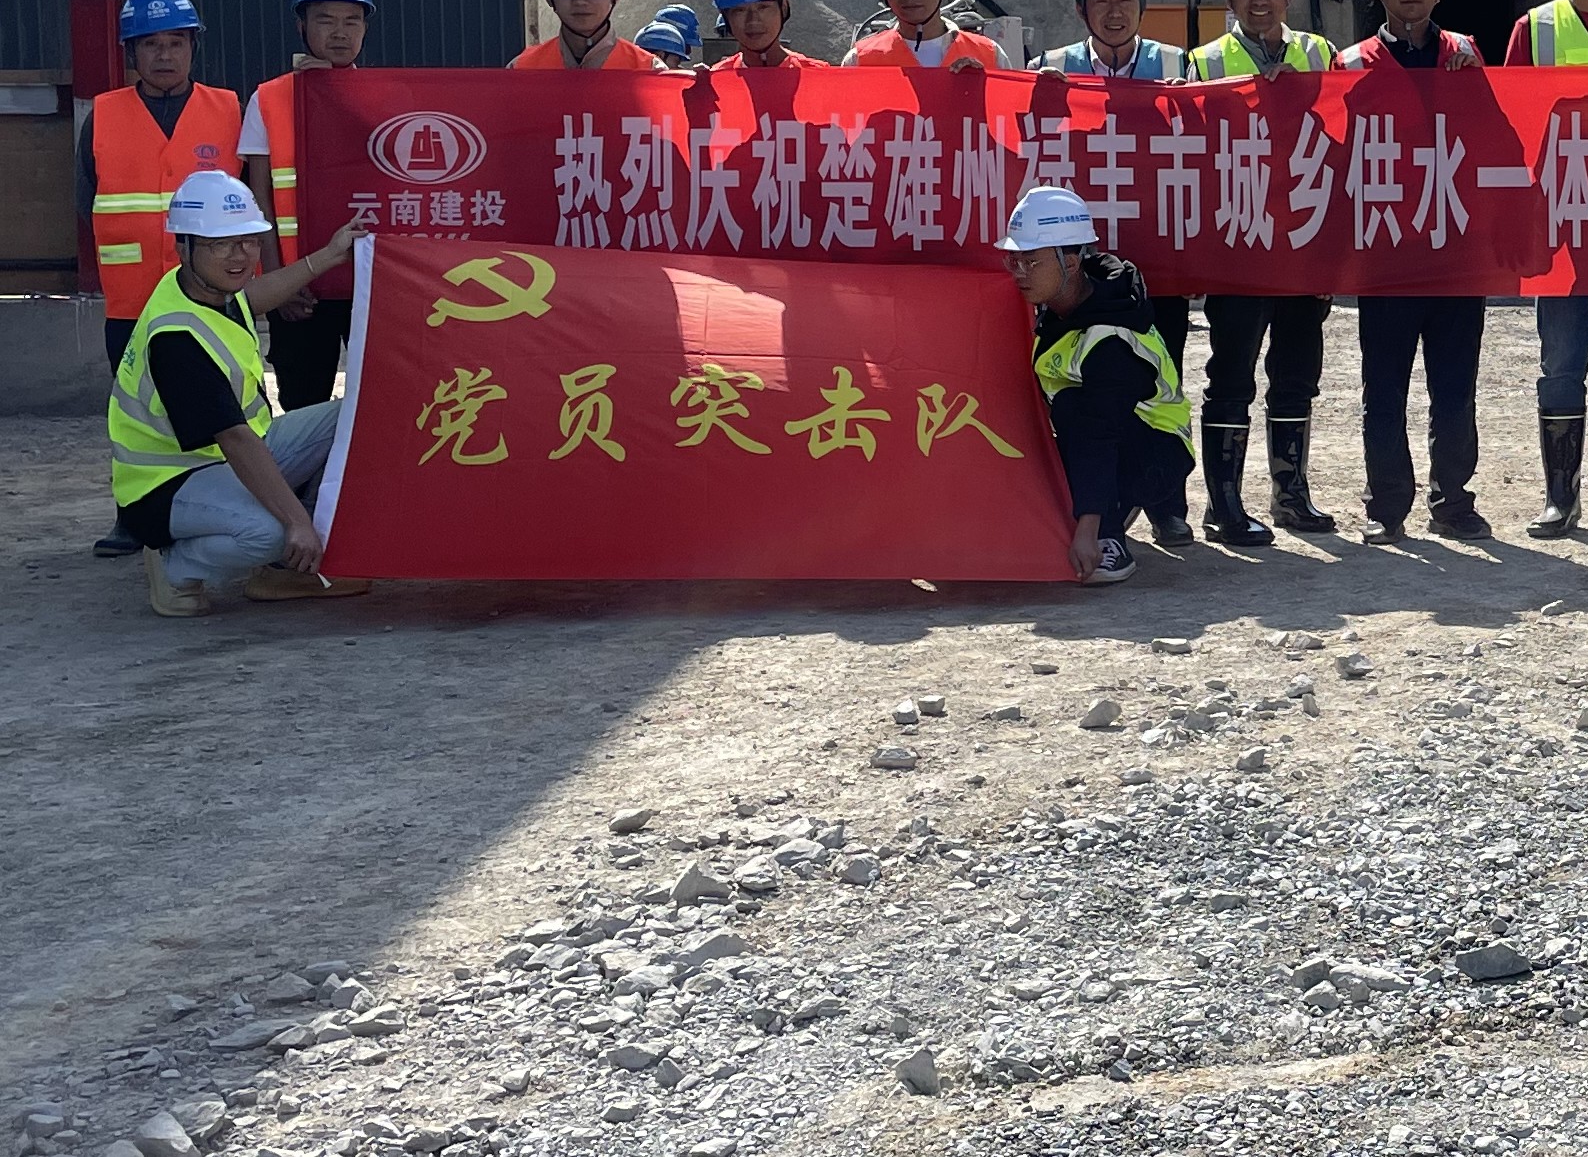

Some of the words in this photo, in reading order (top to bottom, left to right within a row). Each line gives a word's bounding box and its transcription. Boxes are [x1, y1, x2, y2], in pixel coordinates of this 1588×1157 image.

[348, 189, 507, 227] 云南建投
[415, 362, 1025, 466] 党员突击队
